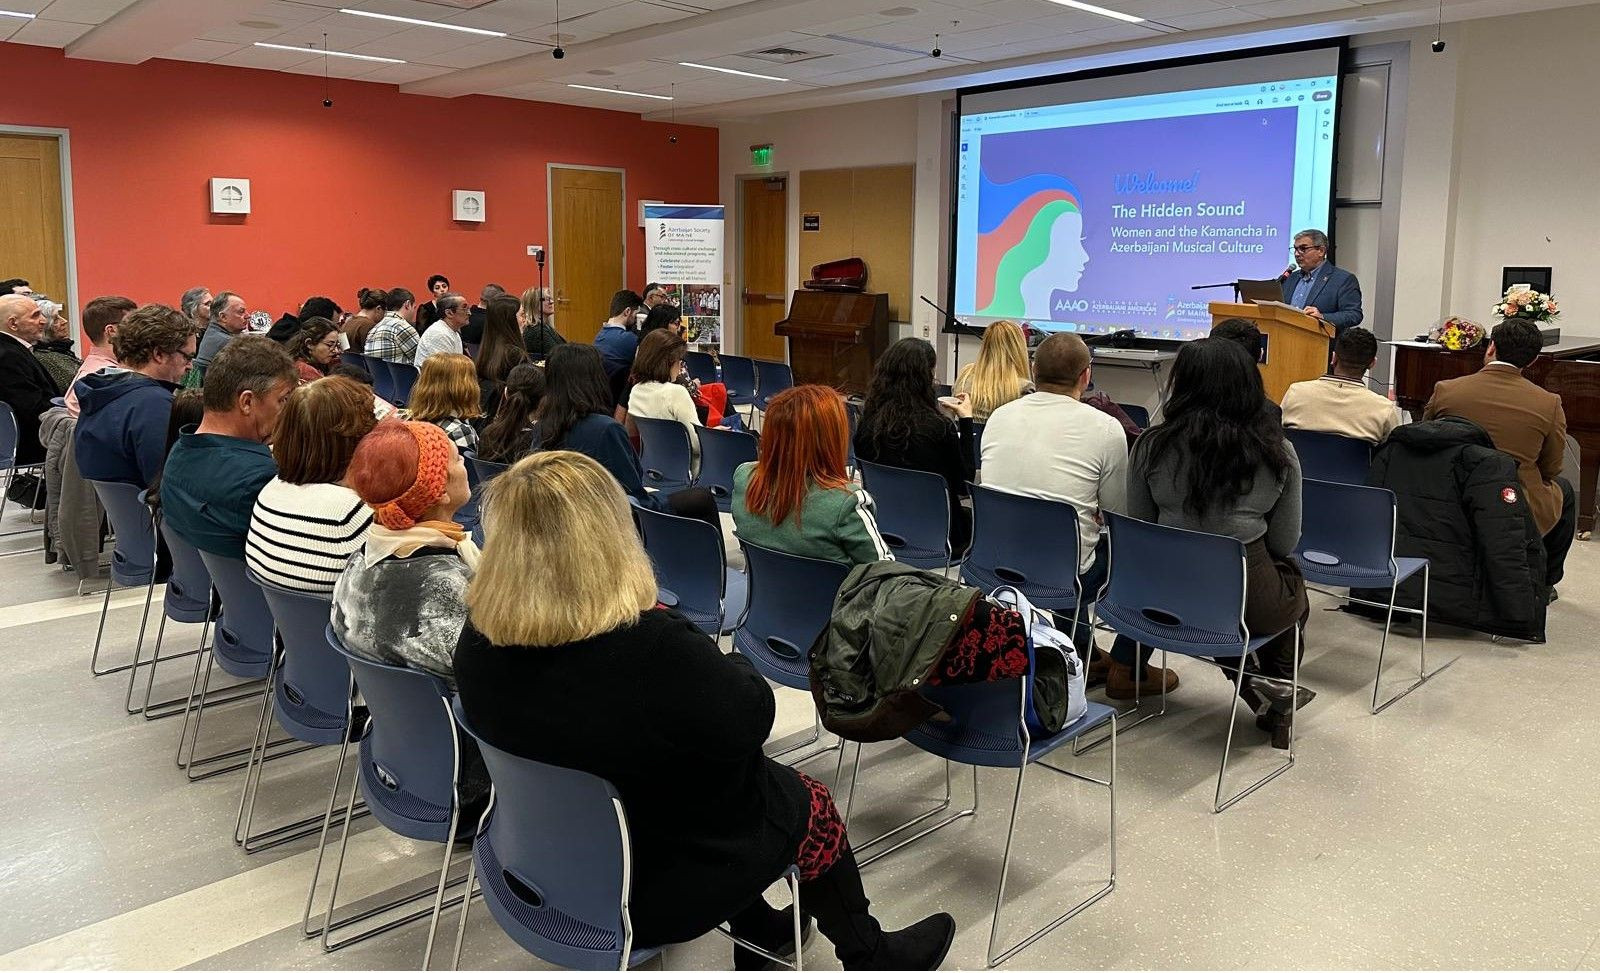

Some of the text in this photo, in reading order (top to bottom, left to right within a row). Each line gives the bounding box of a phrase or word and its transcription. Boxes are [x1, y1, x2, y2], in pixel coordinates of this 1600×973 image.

[1113, 170, 1200, 194] Welcome!
[1112, 200, 1246, 219] The Hidden Sound
[1111, 224, 1278, 238] Women and the Kamancha in
[1110, 241, 1264, 255] Azerbaijani Musical Culture
[1055, 299, 1089, 312] AAAO
